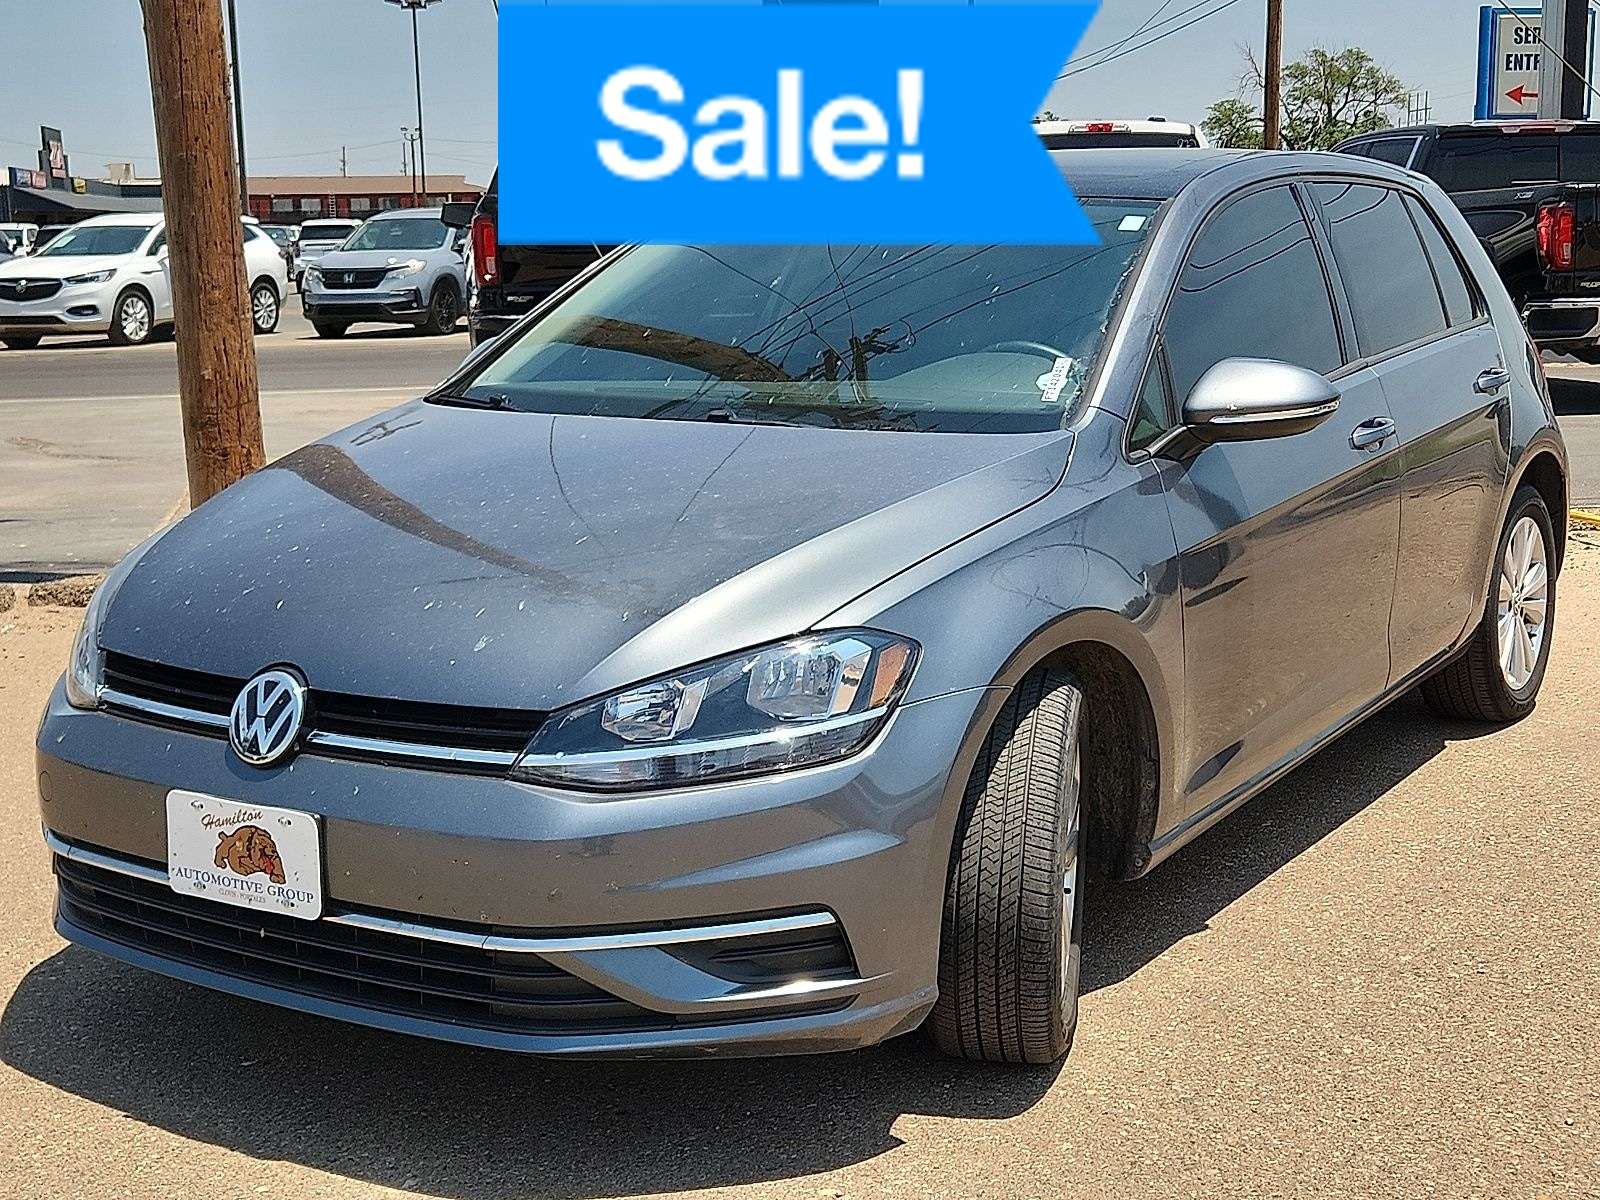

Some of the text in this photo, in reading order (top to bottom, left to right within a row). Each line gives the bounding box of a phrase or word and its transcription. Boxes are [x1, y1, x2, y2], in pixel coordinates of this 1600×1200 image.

[201, 809, 263, 830] Hamilton
[175, 866, 314, 904] AUTOMOTIVE GROUP
